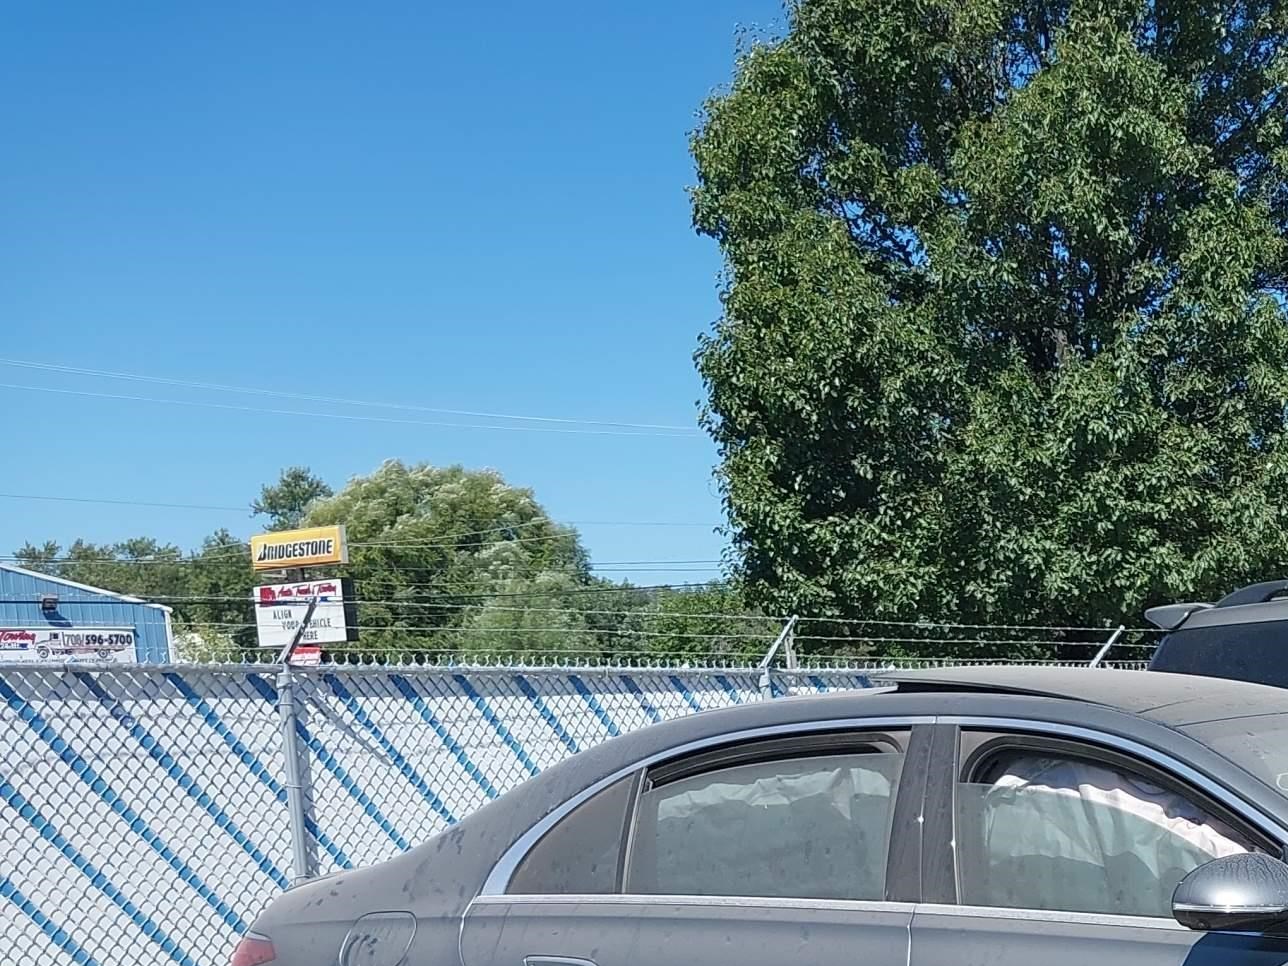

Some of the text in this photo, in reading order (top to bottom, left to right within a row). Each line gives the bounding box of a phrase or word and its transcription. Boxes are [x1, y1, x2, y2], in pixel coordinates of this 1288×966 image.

[257, 539, 333, 561] BRIDGESTONE
[273, 609, 292, 620] ALIGN
[309, 618, 332, 629] EHICLE
